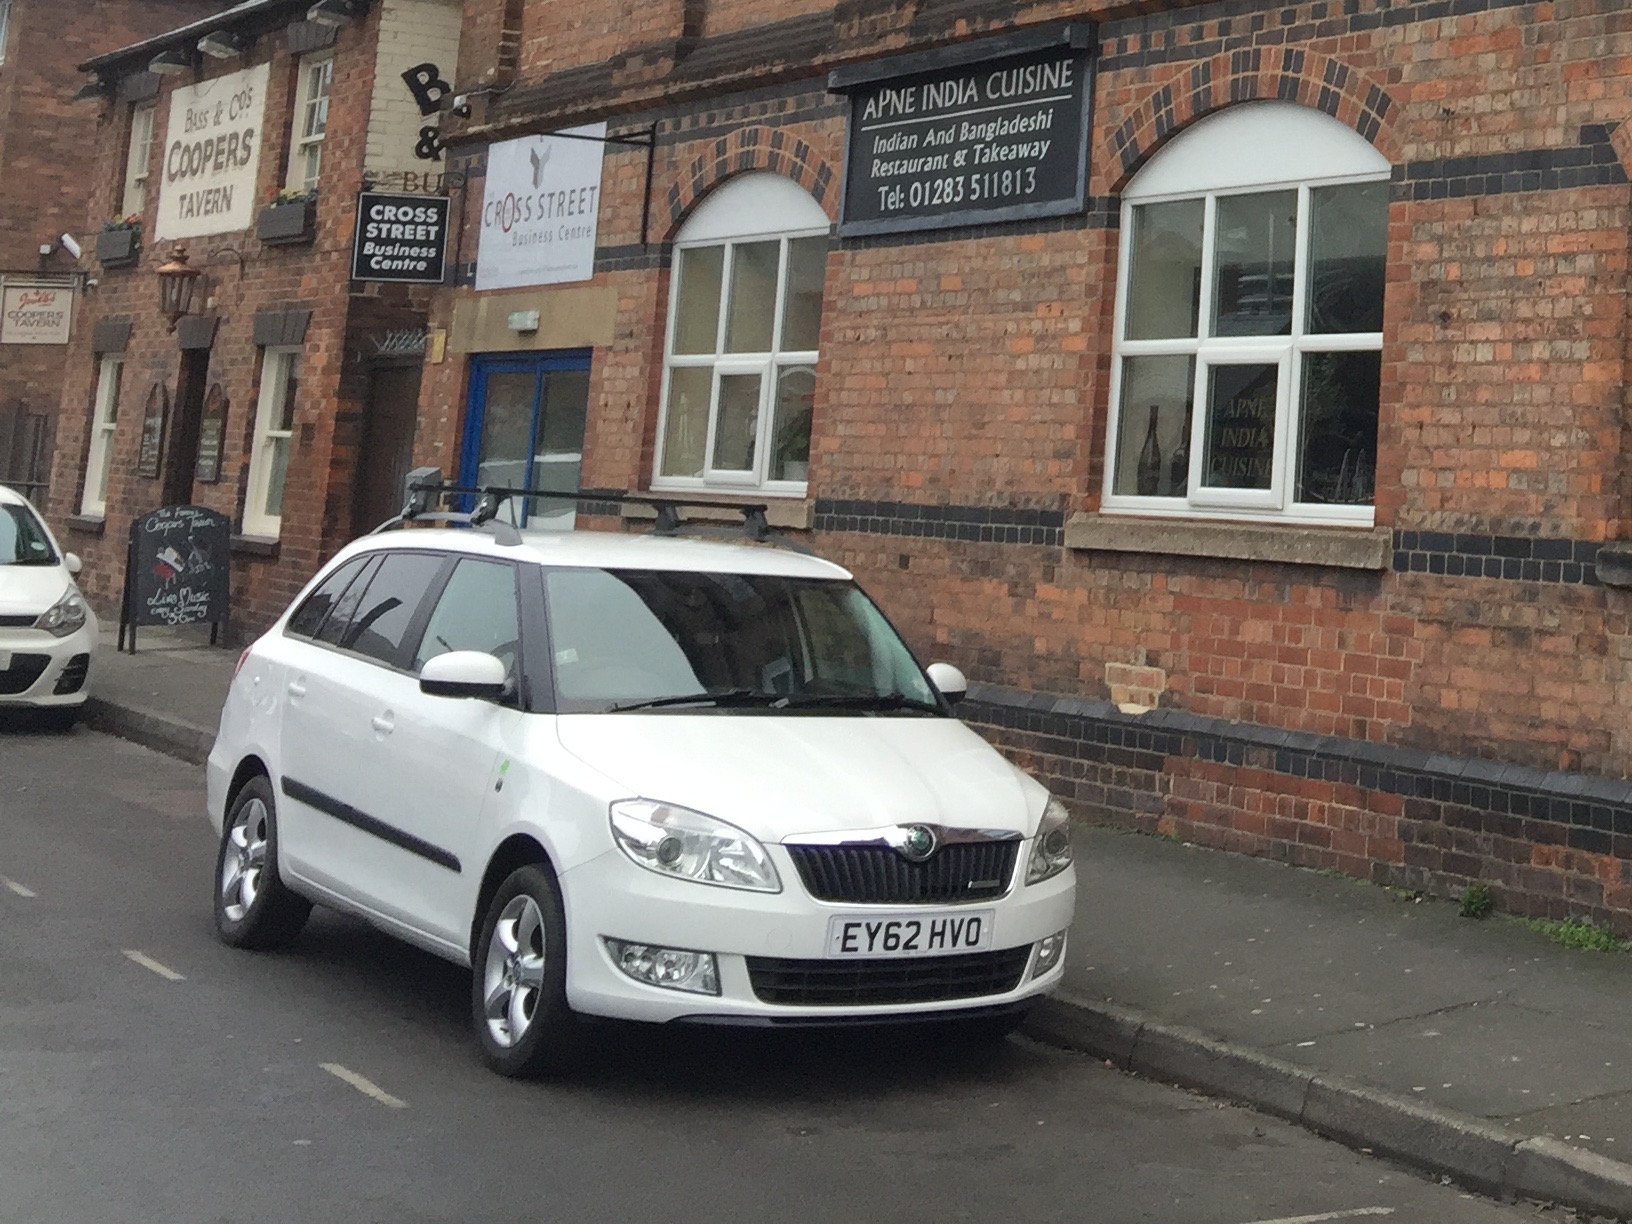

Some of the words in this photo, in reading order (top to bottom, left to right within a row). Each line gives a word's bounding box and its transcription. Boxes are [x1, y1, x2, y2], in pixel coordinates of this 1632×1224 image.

[862, 87, 916, 120] APNE
[921, 77, 979, 111] INDIA
[986, 59, 1074, 100] CUISINE
[213, 100, 224, 127] &
[872, 131, 917, 155] Indian
[923, 125, 954, 147] And
[959, 108, 1054, 142] Bangladeshi
[167, 128, 254, 183] COOPERS
[871, 152, 949, 178] Restaurant
[953, 150, 966, 168] &
[973, 139, 1051, 165] Takeaway
[178, 184, 234, 219] TAVERN
[877, 184, 905, 211] Tel:
[909, 176, 965, 207] 01283
[970, 166, 1037, 201] 511813
[370, 204, 439, 223] CROSS
[484, 192, 533, 233] CROSS
[536, 185, 597, 221] STREET
[365, 222, 440, 241] STREET
[512, 228, 553, 247] Business
[558, 224, 592, 242] Centre
[362, 241, 437, 258] Business
[369, 256, 428, 271] Centre
[840, 920, 922, 952] EY62
[928, 916, 982, 950] HVO
